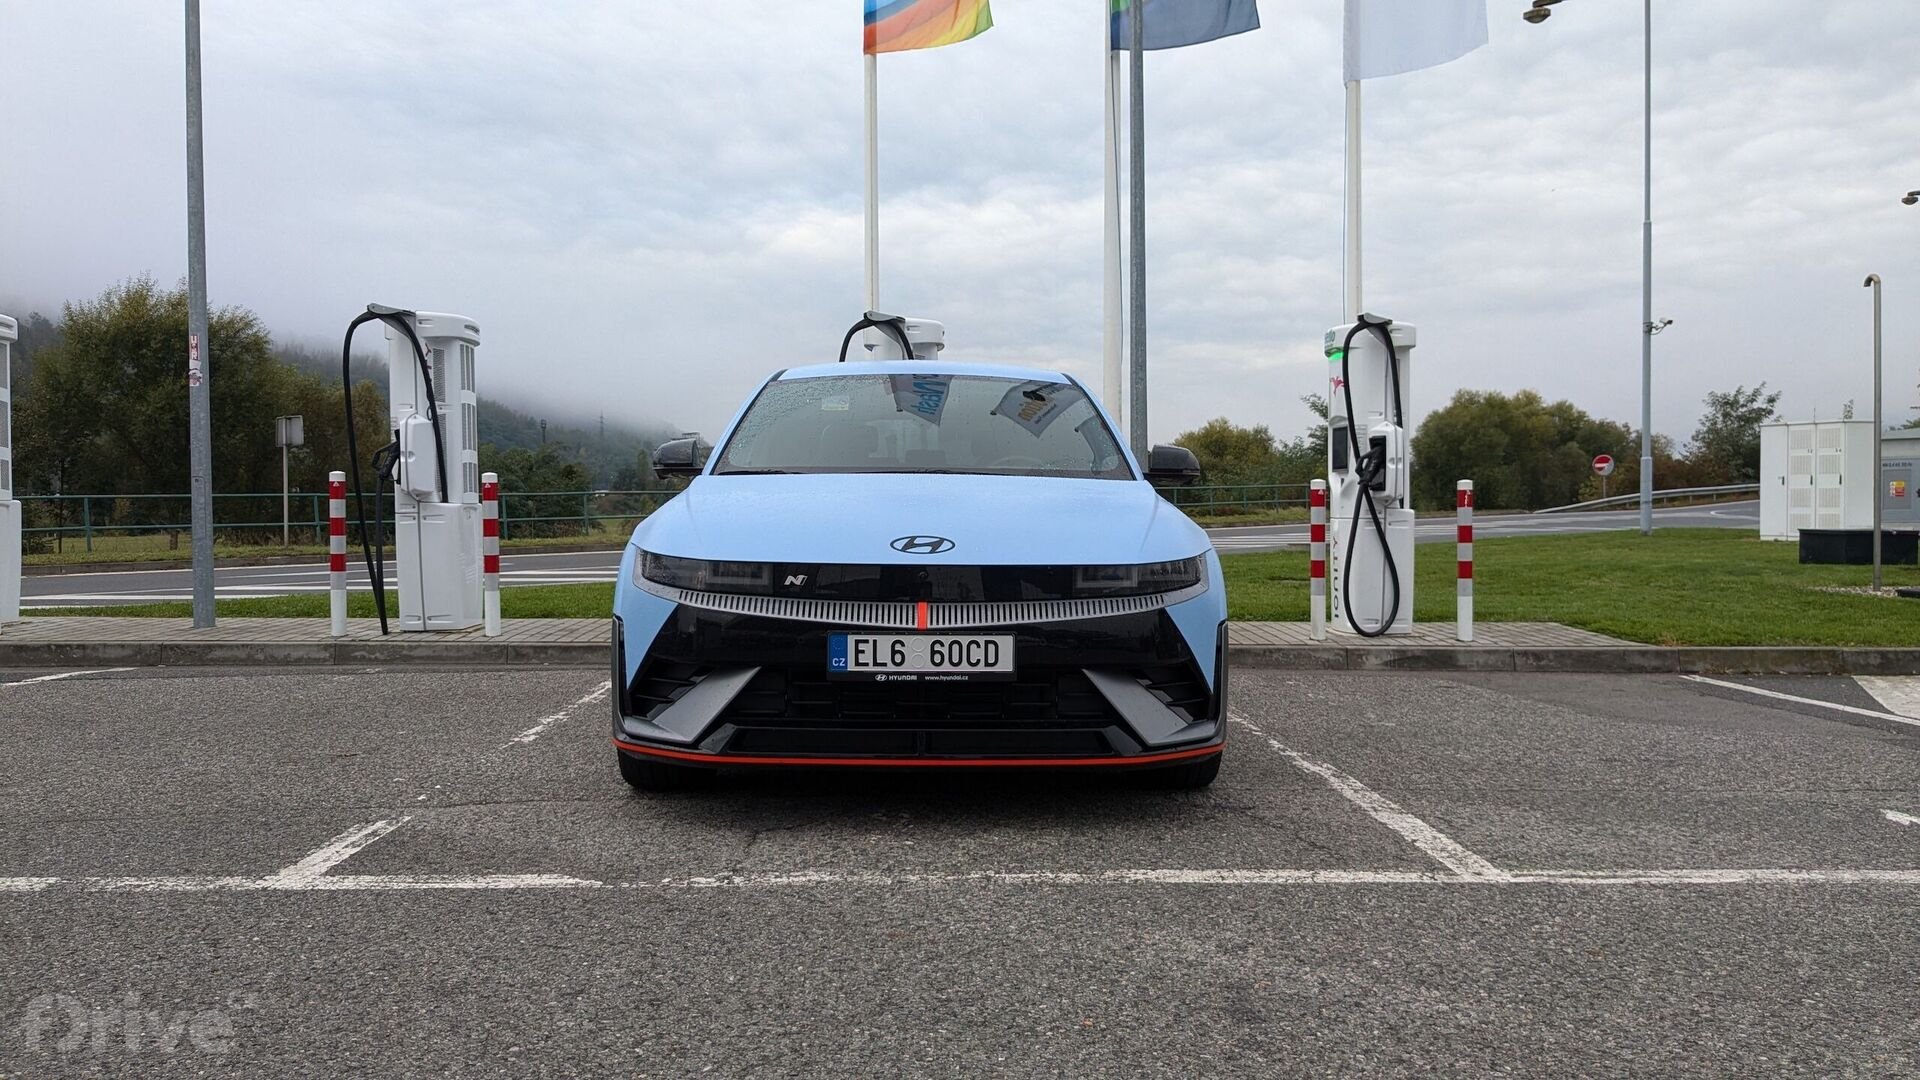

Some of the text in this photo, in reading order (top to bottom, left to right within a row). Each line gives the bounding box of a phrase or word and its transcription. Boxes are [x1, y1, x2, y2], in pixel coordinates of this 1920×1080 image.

[854, 639, 999, 667] EL6 60CD
[832, 658, 846, 667] CZ
[925, 674, 968, 682] www.hyundai.cz
